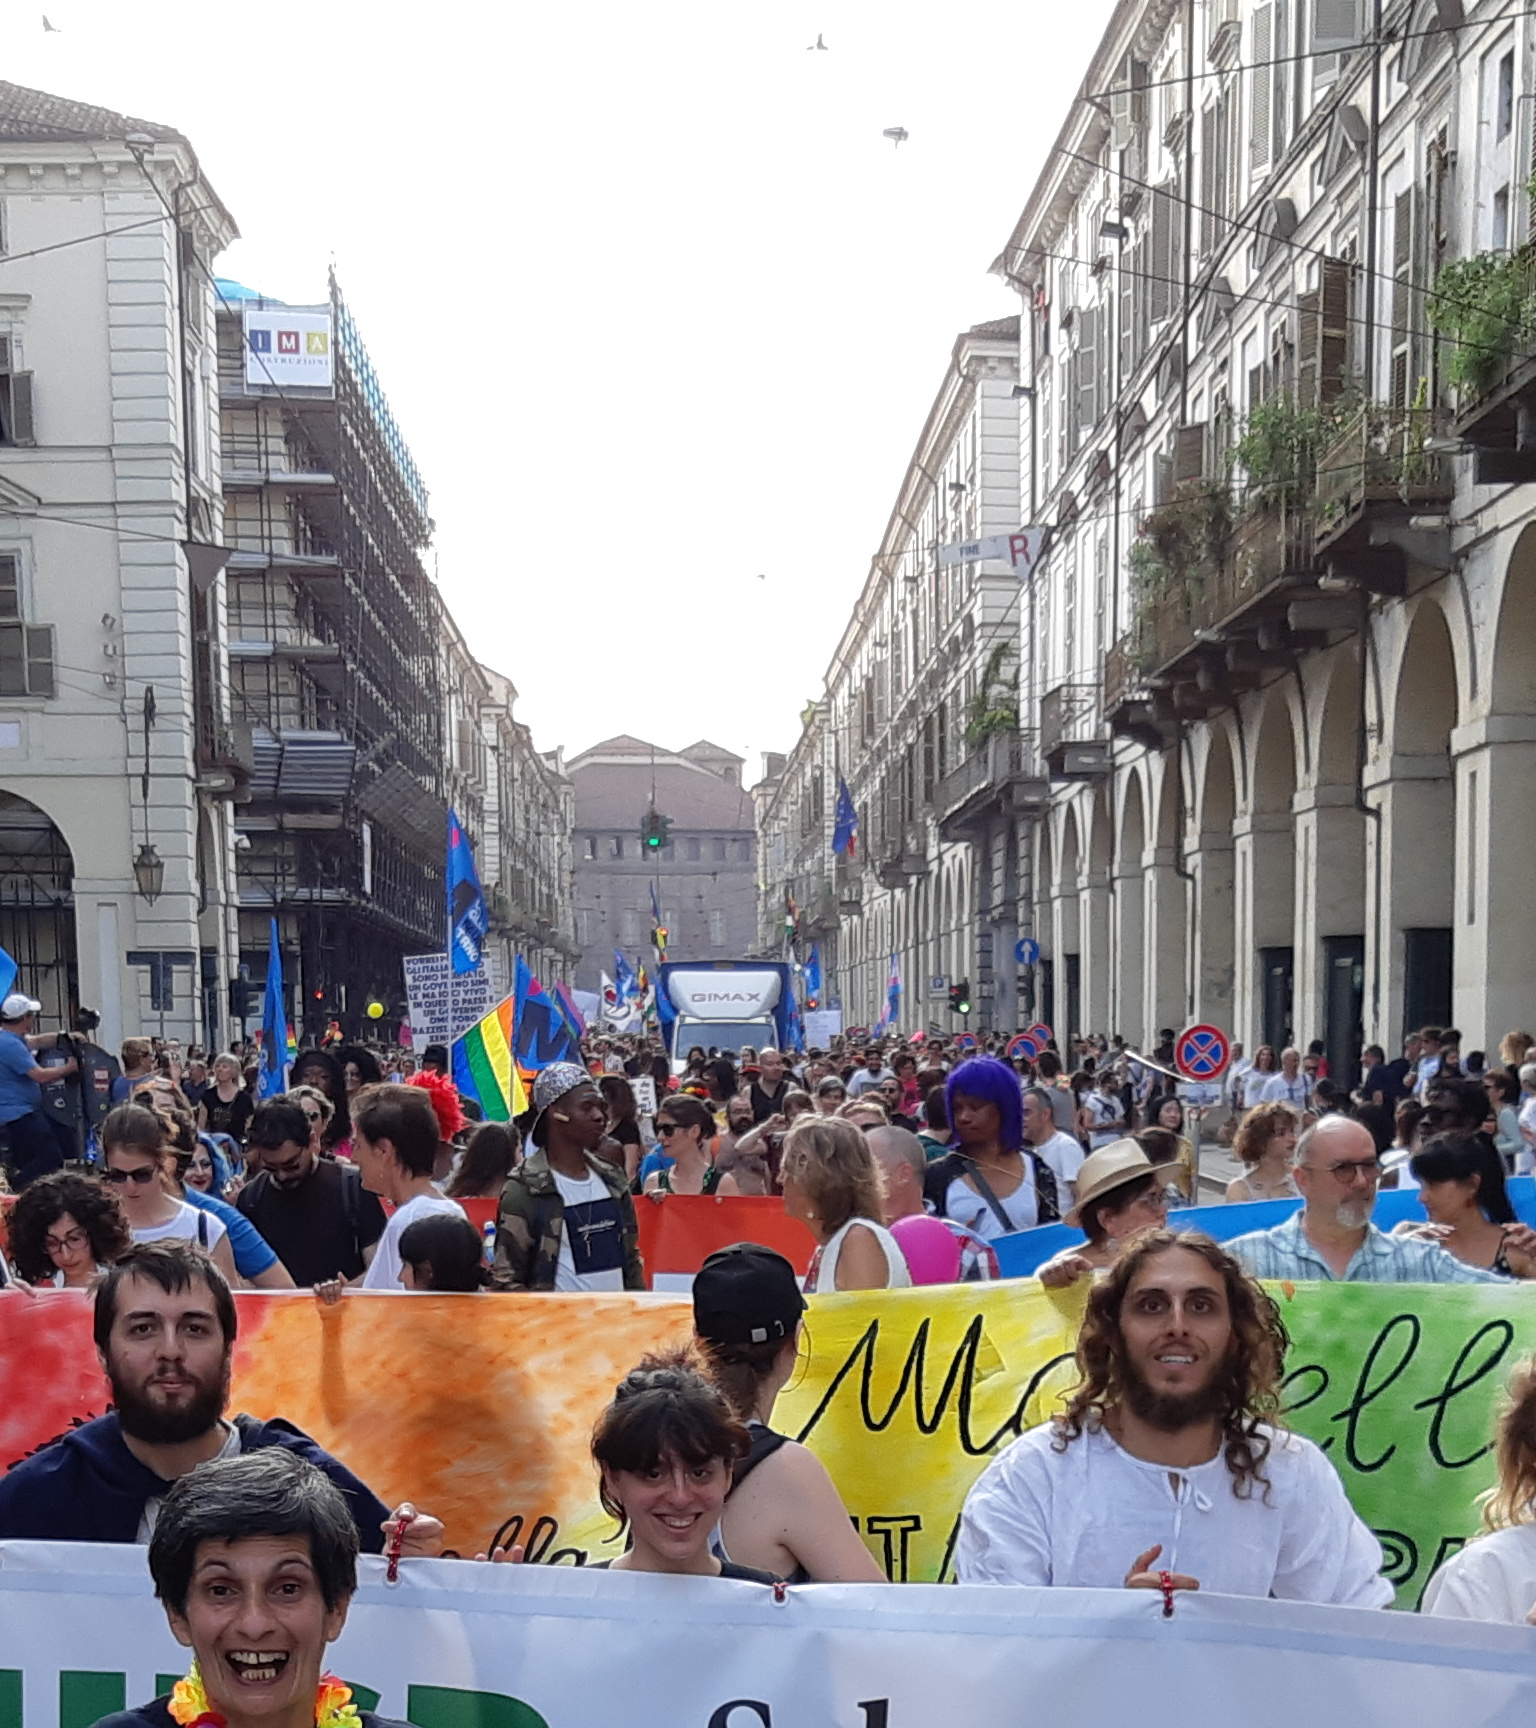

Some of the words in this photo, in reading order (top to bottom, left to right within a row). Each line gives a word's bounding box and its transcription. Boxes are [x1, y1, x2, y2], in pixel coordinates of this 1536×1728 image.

[249, 356, 329, 367] CSTRUZIONI
[1009, 534, 1031, 567] R
[691, 992, 761, 1003] GIMAX
